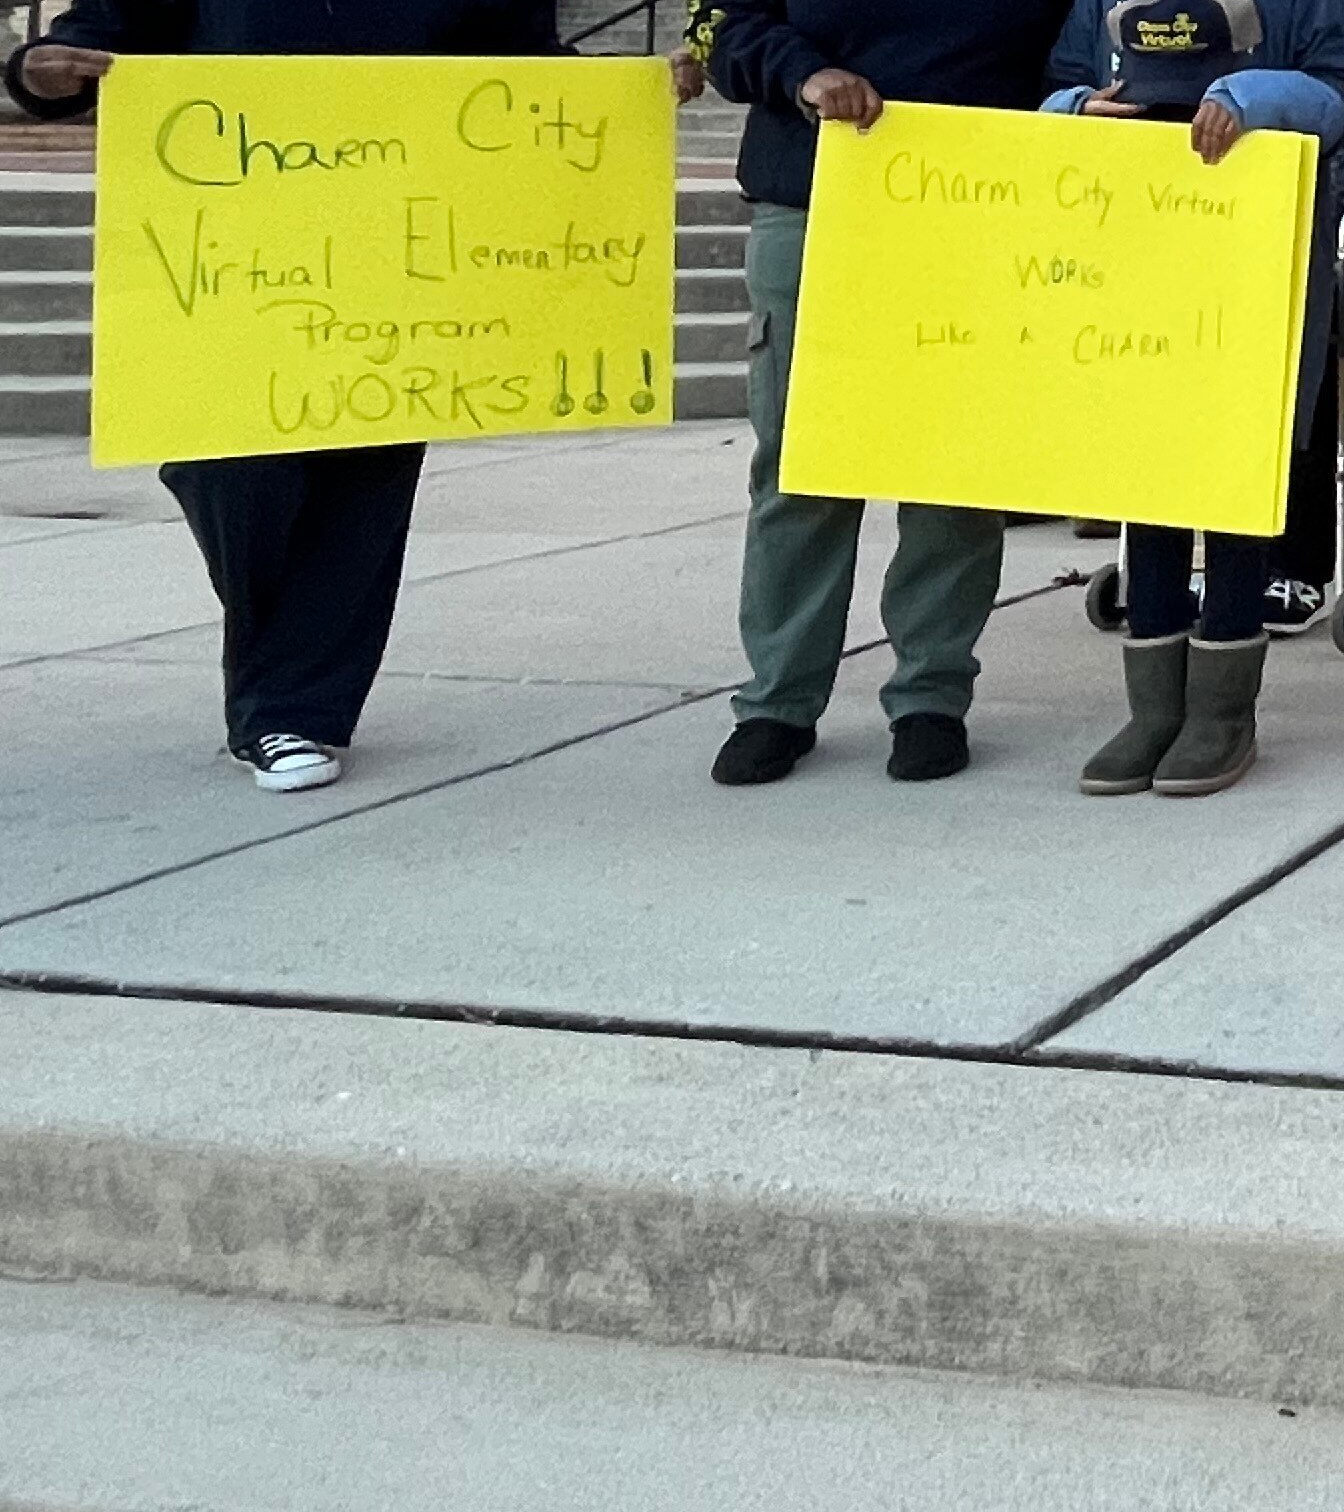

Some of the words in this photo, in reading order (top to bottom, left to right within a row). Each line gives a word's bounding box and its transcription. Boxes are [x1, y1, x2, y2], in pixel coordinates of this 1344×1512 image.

[457, 79, 608, 173] City
[884, 150, 1021, 207] Charm
[1055, 164, 1114, 228] City
[1147, 181, 1238, 222] Virtual
[141, 206, 334, 318] Virtual
[402, 196, 646, 288] Elementary
[255, 299, 511, 366] Program
